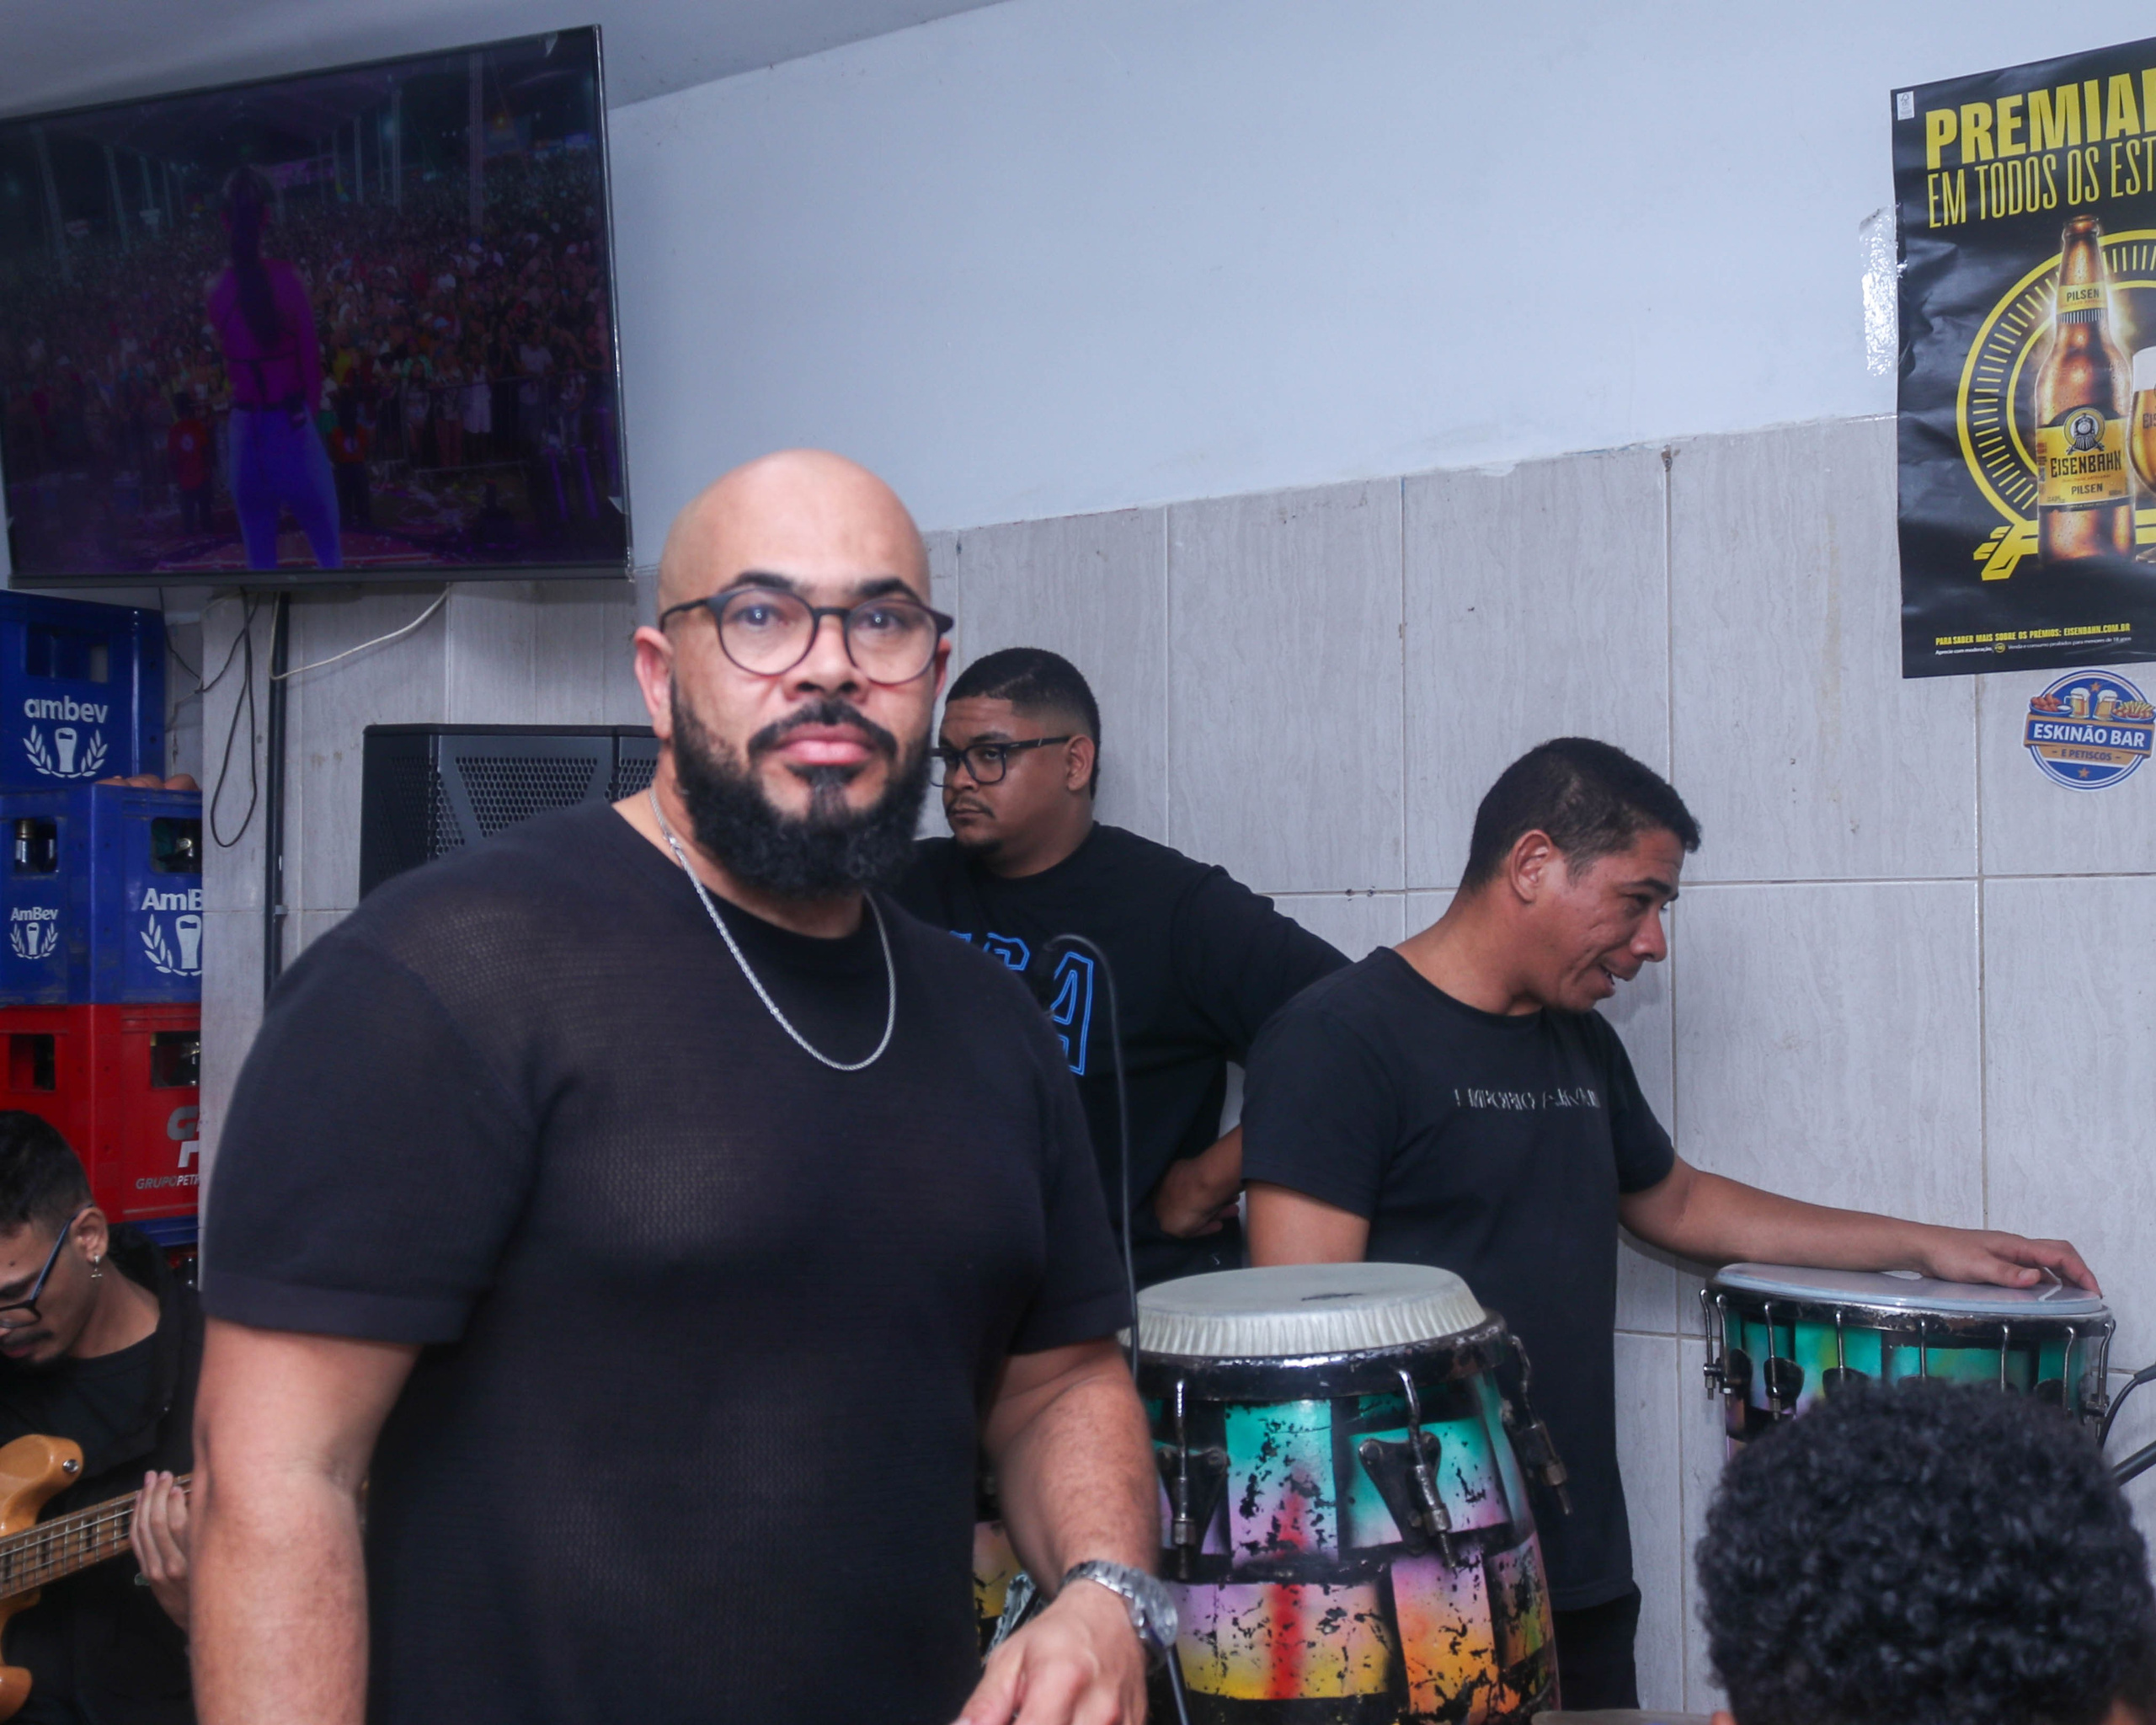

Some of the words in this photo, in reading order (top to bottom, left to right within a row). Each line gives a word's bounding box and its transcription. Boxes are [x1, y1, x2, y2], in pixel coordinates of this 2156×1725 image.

[1927, 169, 1967, 228] EM
[1975, 154, 2057, 220] TODOS
[2067, 146, 2100, 206] OS
[2067, 288, 2100, 302] PILSEN
[2050, 450, 2121, 478] EISENBAHN
[2071, 483, 2103, 495] PILSEN
[1935, 637, 1952, 645] PARA
[1953, 635, 1974, 644] SABER
[1976, 633, 1993, 643] MAIS
[1995, 632, 2016, 641] SOBRE
[2018, 631, 2027, 639] OS
[24, 694, 109, 724] ambev
[2033, 723, 2107, 744] ESKINÃO
[2110, 729, 2145, 748] BAR
[2061, 749, 2067, 757] E
[2068, 750, 2112, 761] PETISCOS
[10, 906, 59, 921] AmBev
